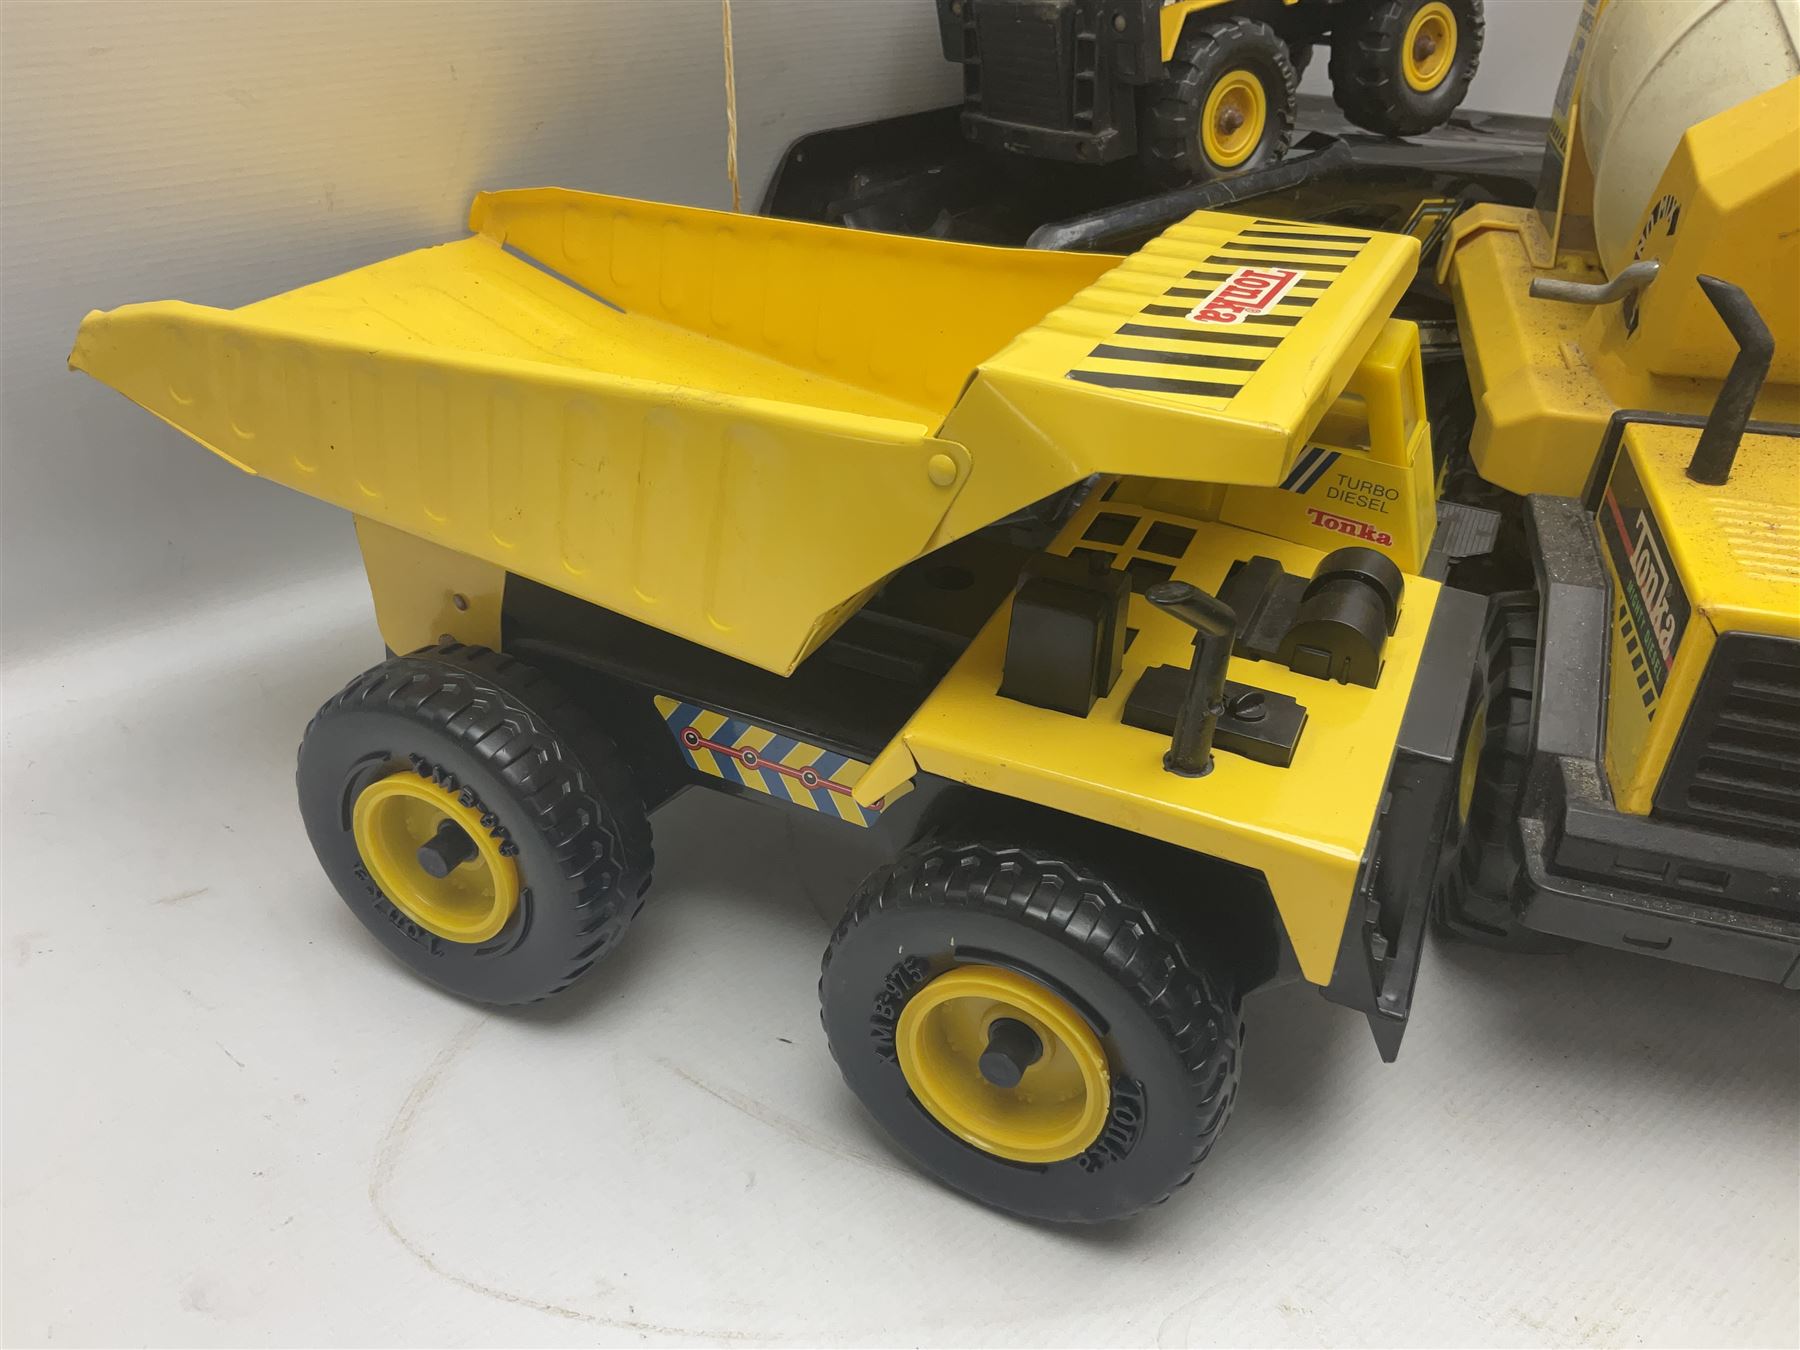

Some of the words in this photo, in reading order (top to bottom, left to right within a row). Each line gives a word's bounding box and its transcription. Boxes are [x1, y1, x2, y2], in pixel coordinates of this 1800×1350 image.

[1193, 269, 1298, 323] Tonka
[1327, 487, 1389, 513] DIESEL
[1338, 473, 1399, 501] TURBO
[1307, 508, 1392, 547] Tonka
[1630, 509, 1676, 661] Tonka
[1625, 579, 1646, 630] MIGHTY
[1643, 628, 1661, 682] DIESEL
